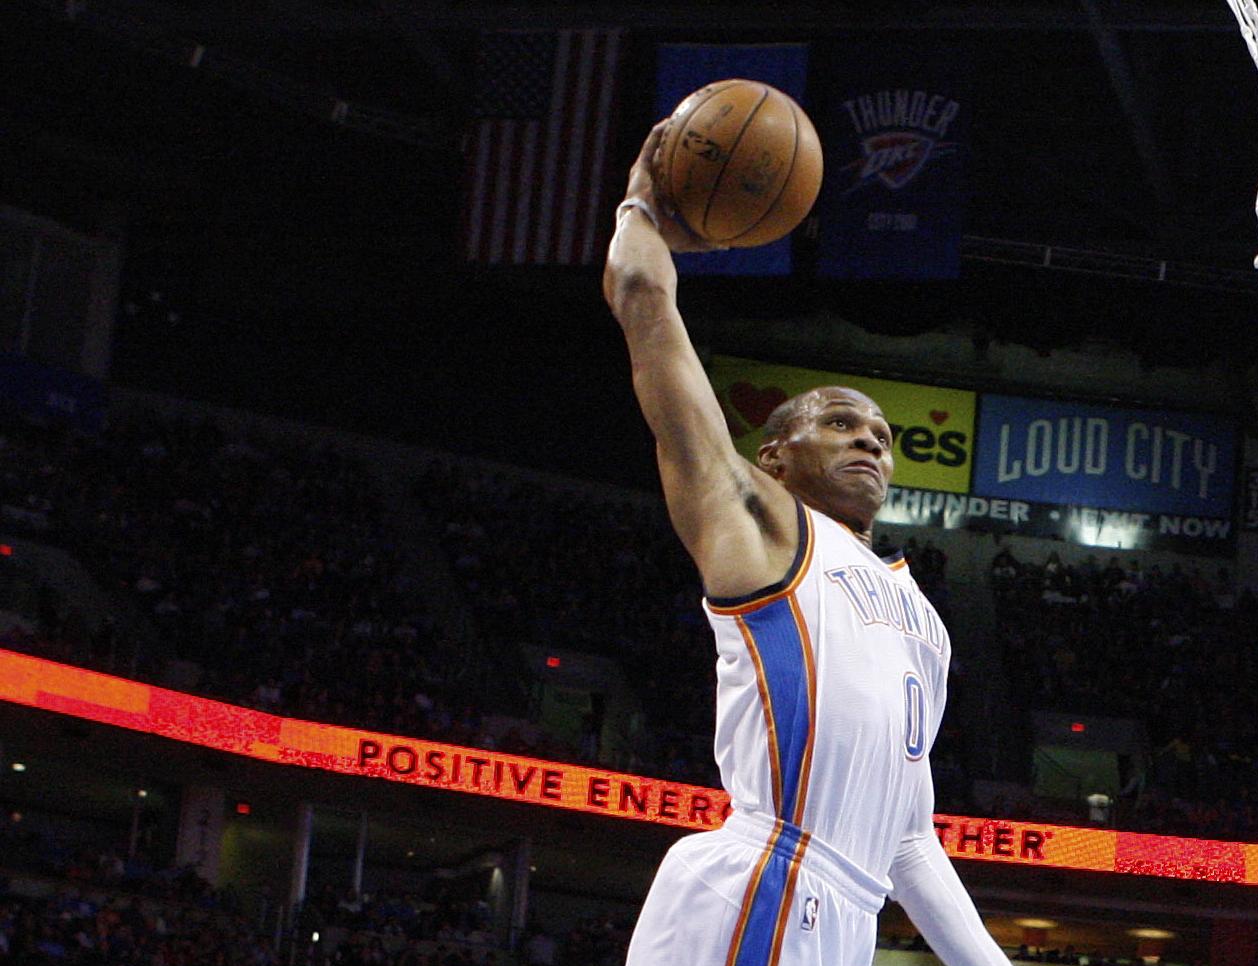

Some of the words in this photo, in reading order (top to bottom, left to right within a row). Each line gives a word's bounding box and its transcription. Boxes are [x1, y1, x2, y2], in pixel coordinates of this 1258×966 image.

[842, 90, 960, 138] THUNDER
[998, 416, 1109, 482] LOUD
[1125, 421, 1217, 500] CITY
[886, 485, 1030, 524] THUNDER
[1160, 514, 1232, 539] NOW
[904, 671, 927, 762] 0
[358, 738, 564, 799] POSITIVE
[588, 776, 732, 827] ENER
